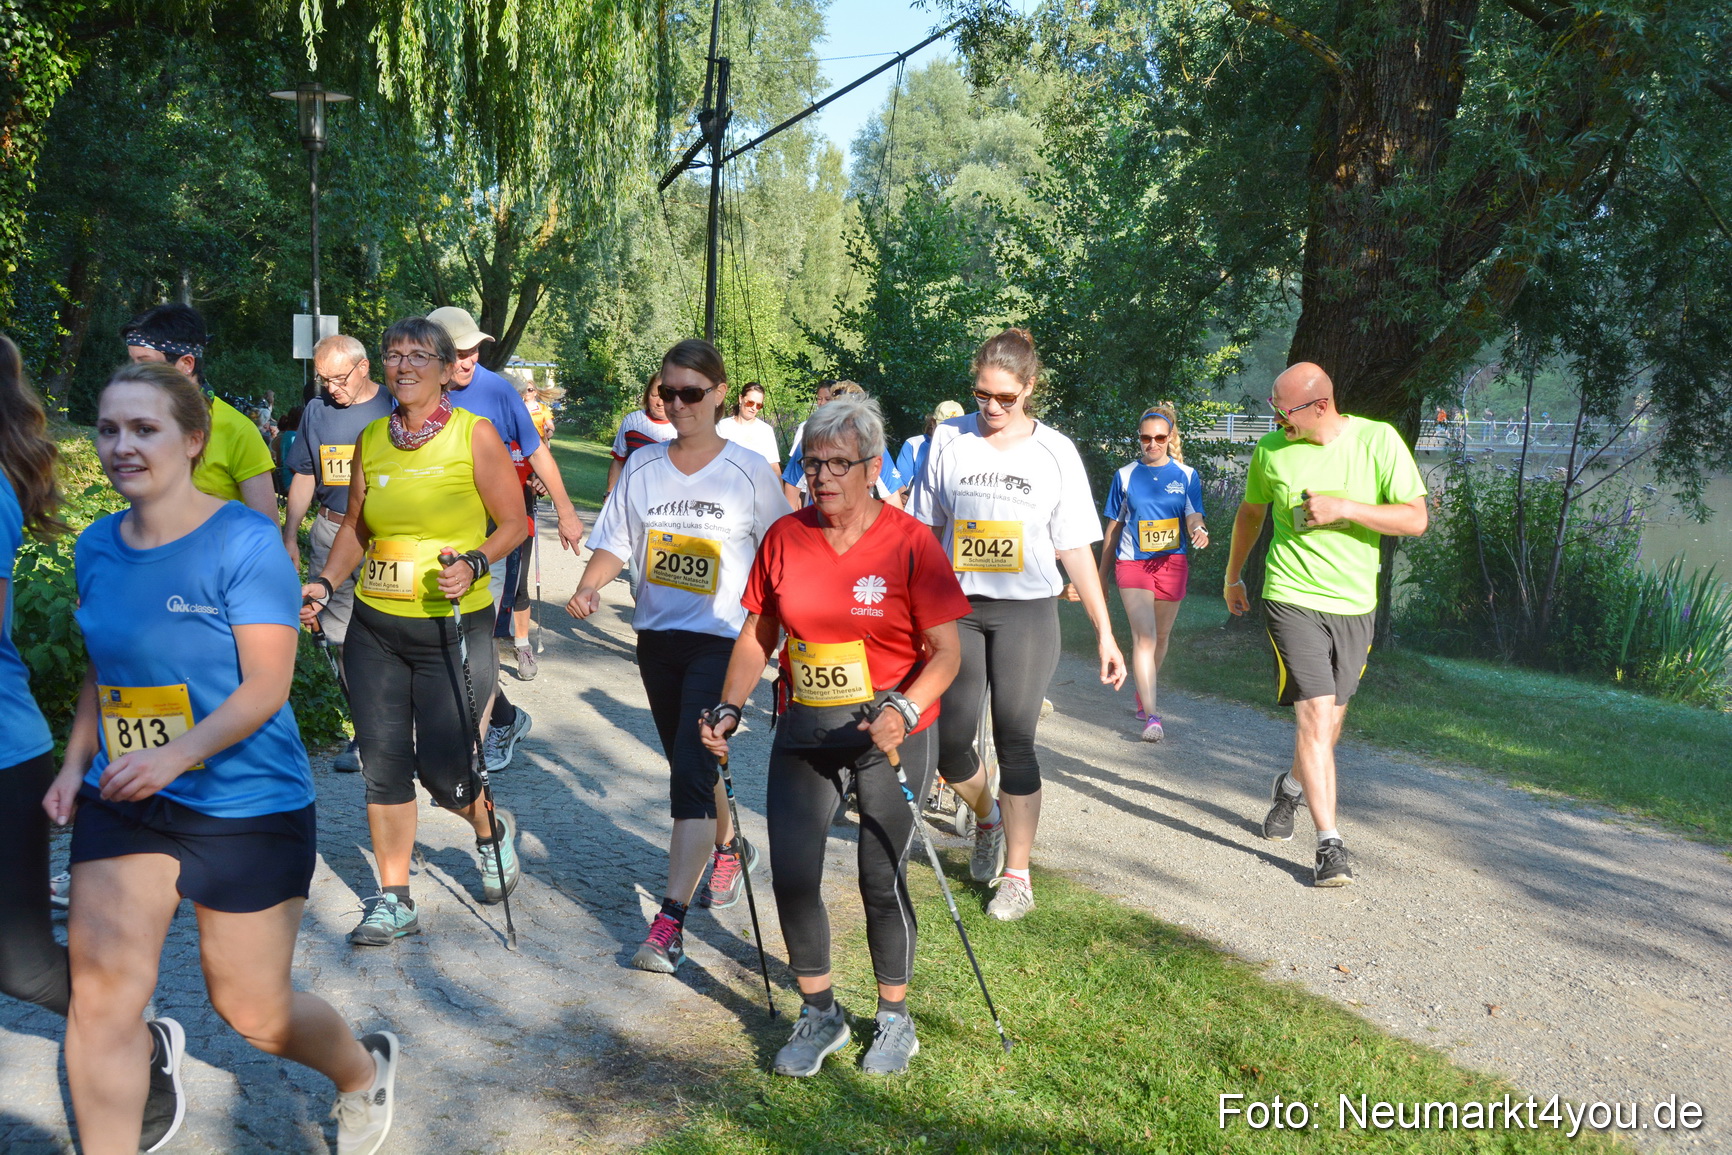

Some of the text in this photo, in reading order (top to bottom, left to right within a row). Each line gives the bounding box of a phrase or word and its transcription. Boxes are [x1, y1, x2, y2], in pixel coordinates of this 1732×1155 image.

[683, 521, 702, 529] Lukas
[1145, 530, 1175, 543] 1974
[961, 538, 1014, 557] 2042
[369, 559, 398, 582] 971
[655, 550, 709, 578] 2039
[683, 576, 709, 585] Natascha
[190, 604, 219, 615] classic
[851, 607, 884, 617] caritas
[801, 664, 848, 688] 356
[832, 686, 862, 695] Theresia
[117, 718, 170, 748] 813
